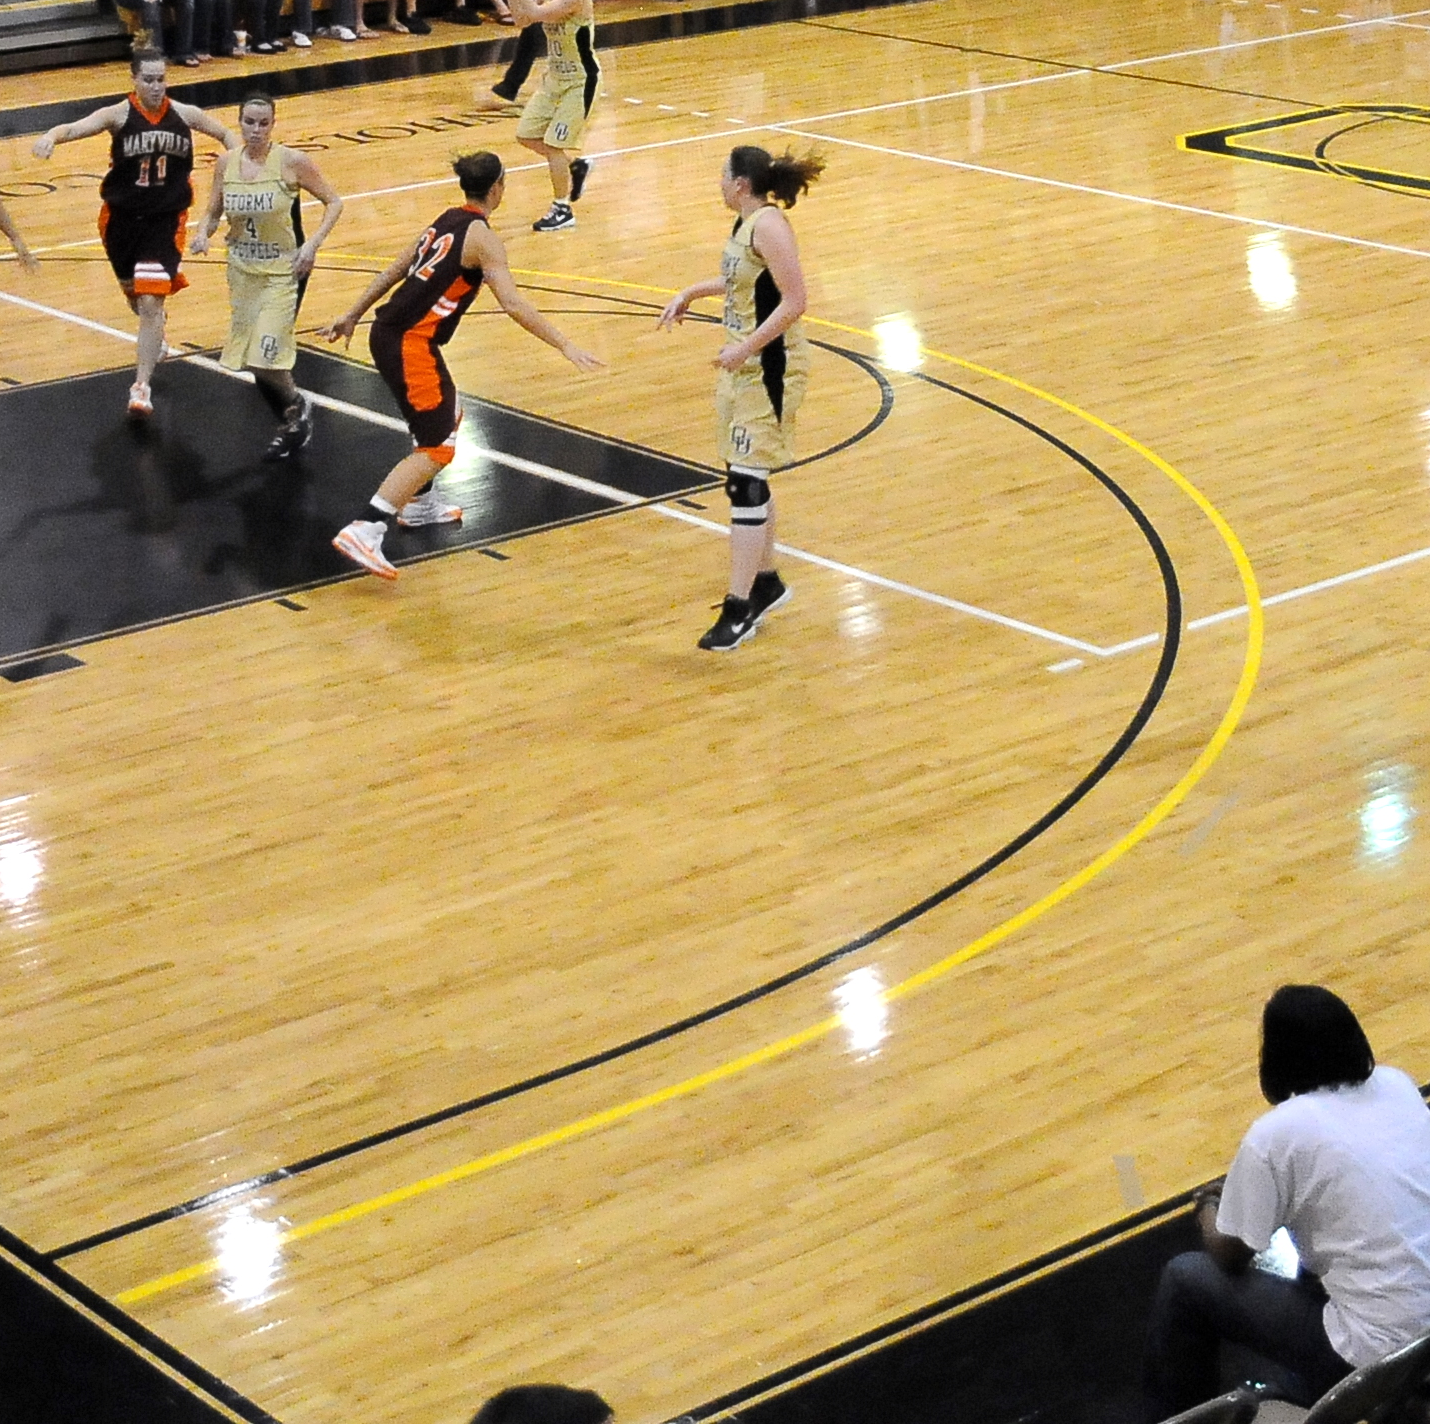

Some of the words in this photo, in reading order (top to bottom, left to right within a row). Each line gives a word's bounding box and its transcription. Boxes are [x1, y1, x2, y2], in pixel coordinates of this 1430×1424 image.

[123, 129, 190, 160] MARYVILLE
[134, 154, 168, 187] 11
[223, 191, 275, 212] STORMY
[244, 216, 259, 239] 4
[408, 226, 454, 282] 32
